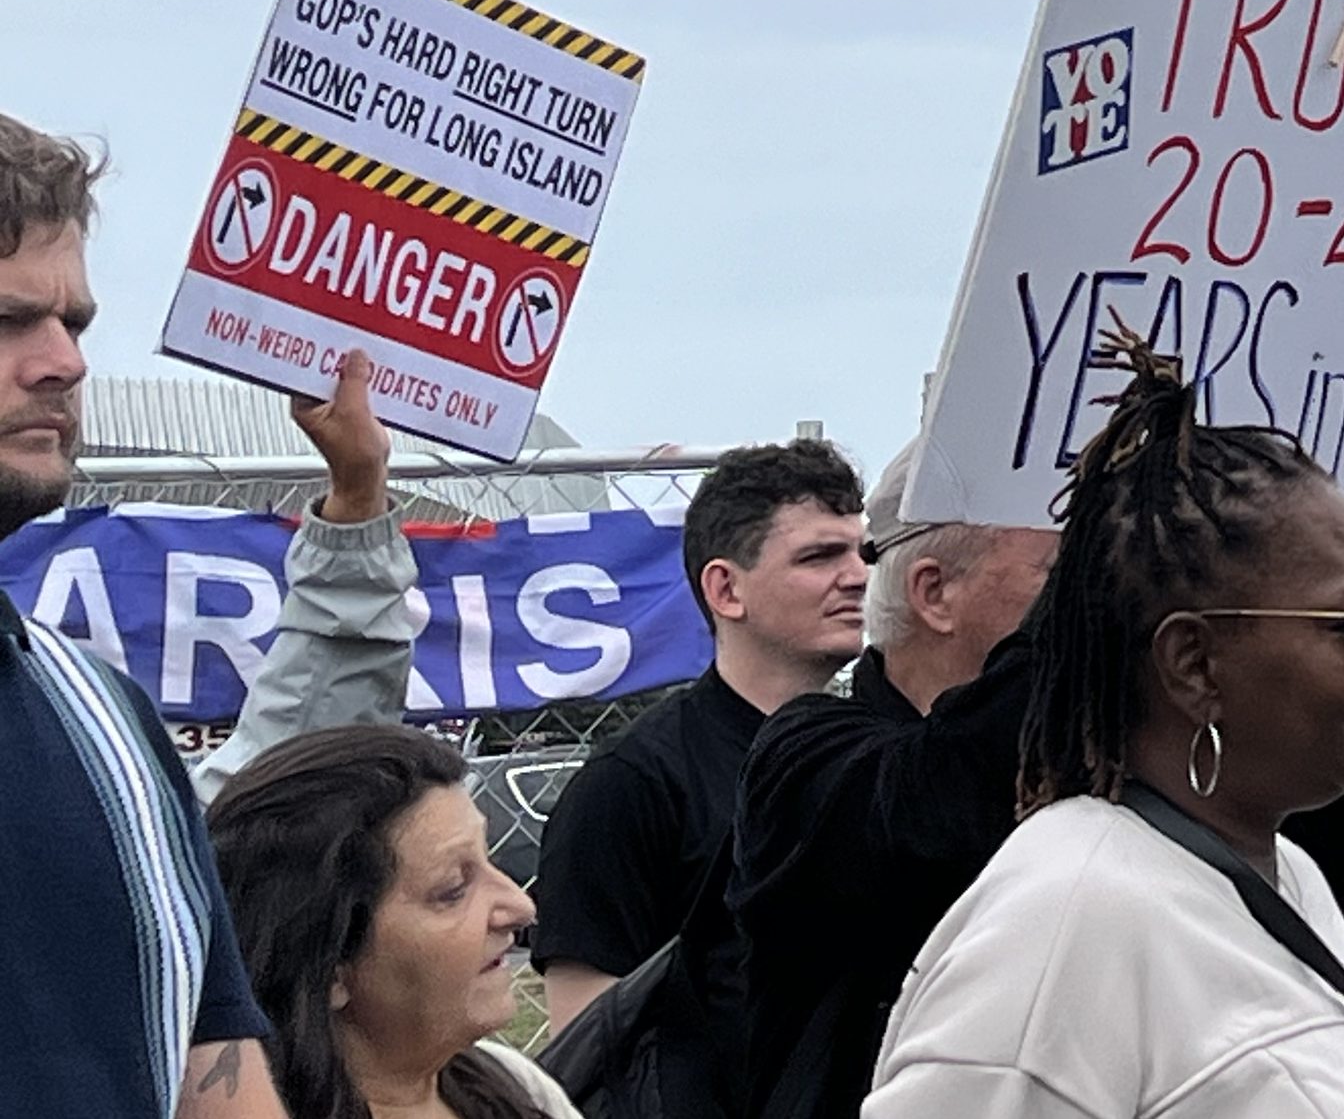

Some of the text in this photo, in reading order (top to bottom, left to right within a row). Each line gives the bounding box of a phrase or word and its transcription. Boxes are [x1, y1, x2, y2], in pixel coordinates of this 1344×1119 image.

[267, 36, 603, 208] WRONG FOR LONG ISLAND
[379, 16, 457, 80] HARD
[456, 50, 543, 117] RIGHT
[544, 86, 618, 148] TURN
[267, 193, 498, 345] DANGER
[204, 306, 498, 430] NON-WEIRD CADIDATES ONLY
[30, 546, 632, 709] ARIS
